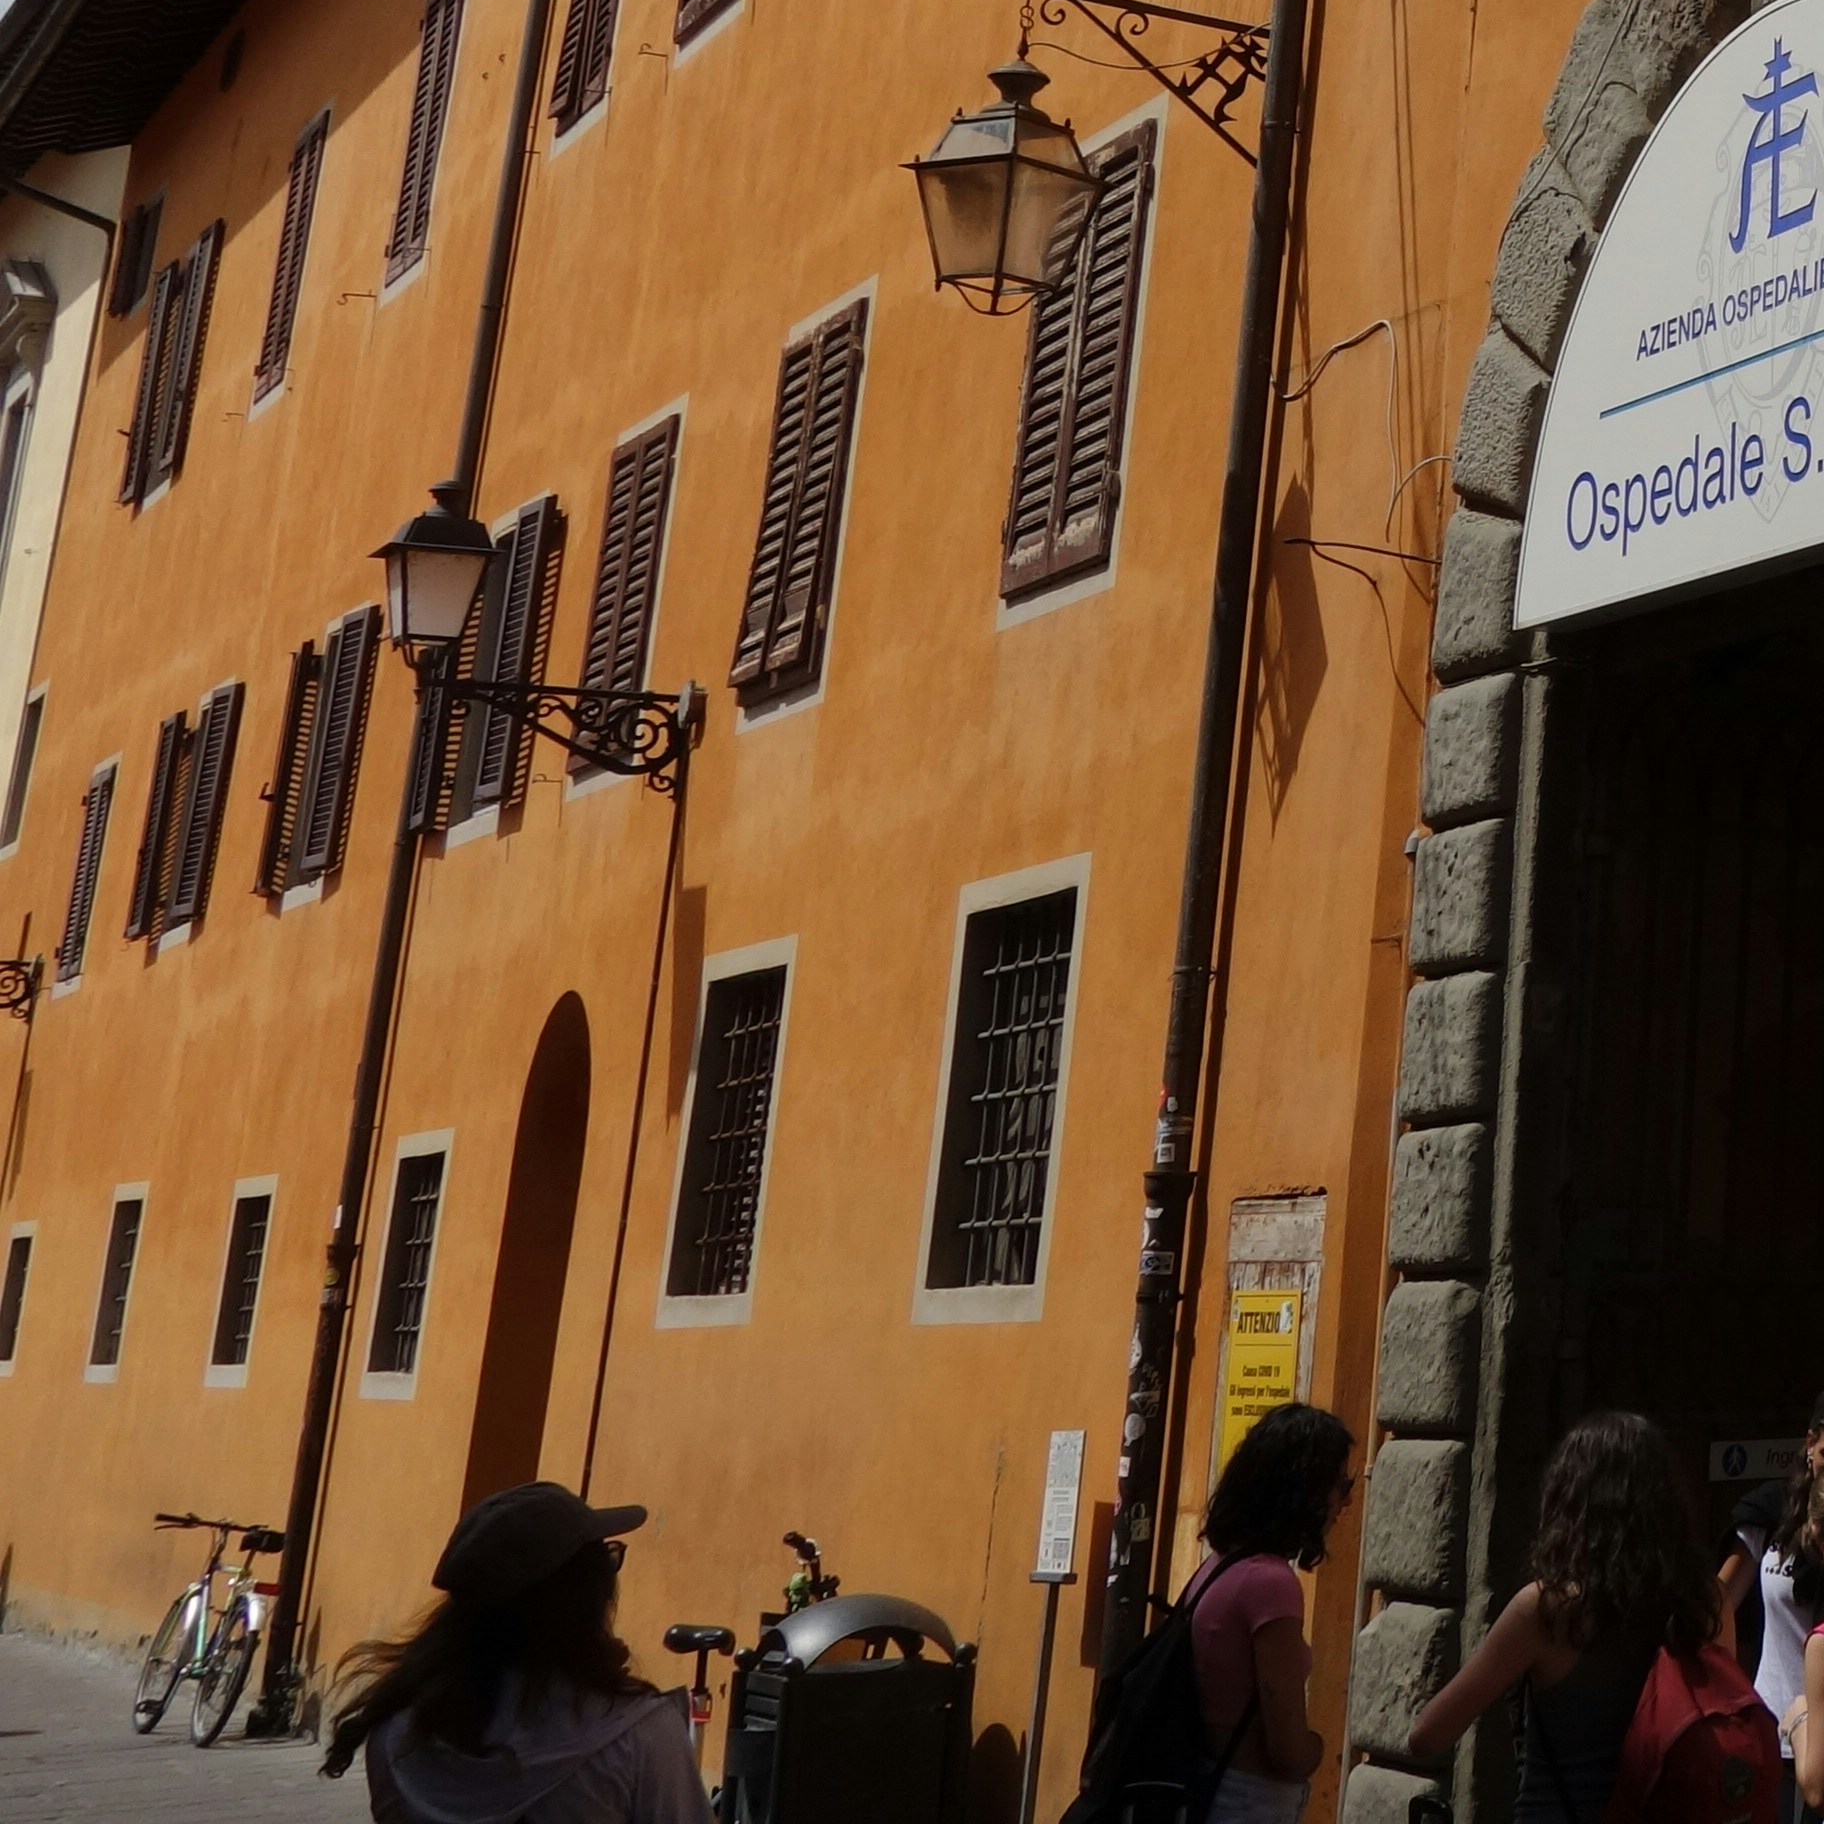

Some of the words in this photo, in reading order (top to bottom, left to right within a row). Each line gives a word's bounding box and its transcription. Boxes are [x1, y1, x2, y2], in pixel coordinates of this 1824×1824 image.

[1636, 307, 1718, 361] AZIENDA
[1566, 422, 1765, 557] Ospedale
[1782, 396, 1824, 482] S.
[1236, 1311, 1293, 1334] ATTENZIO
